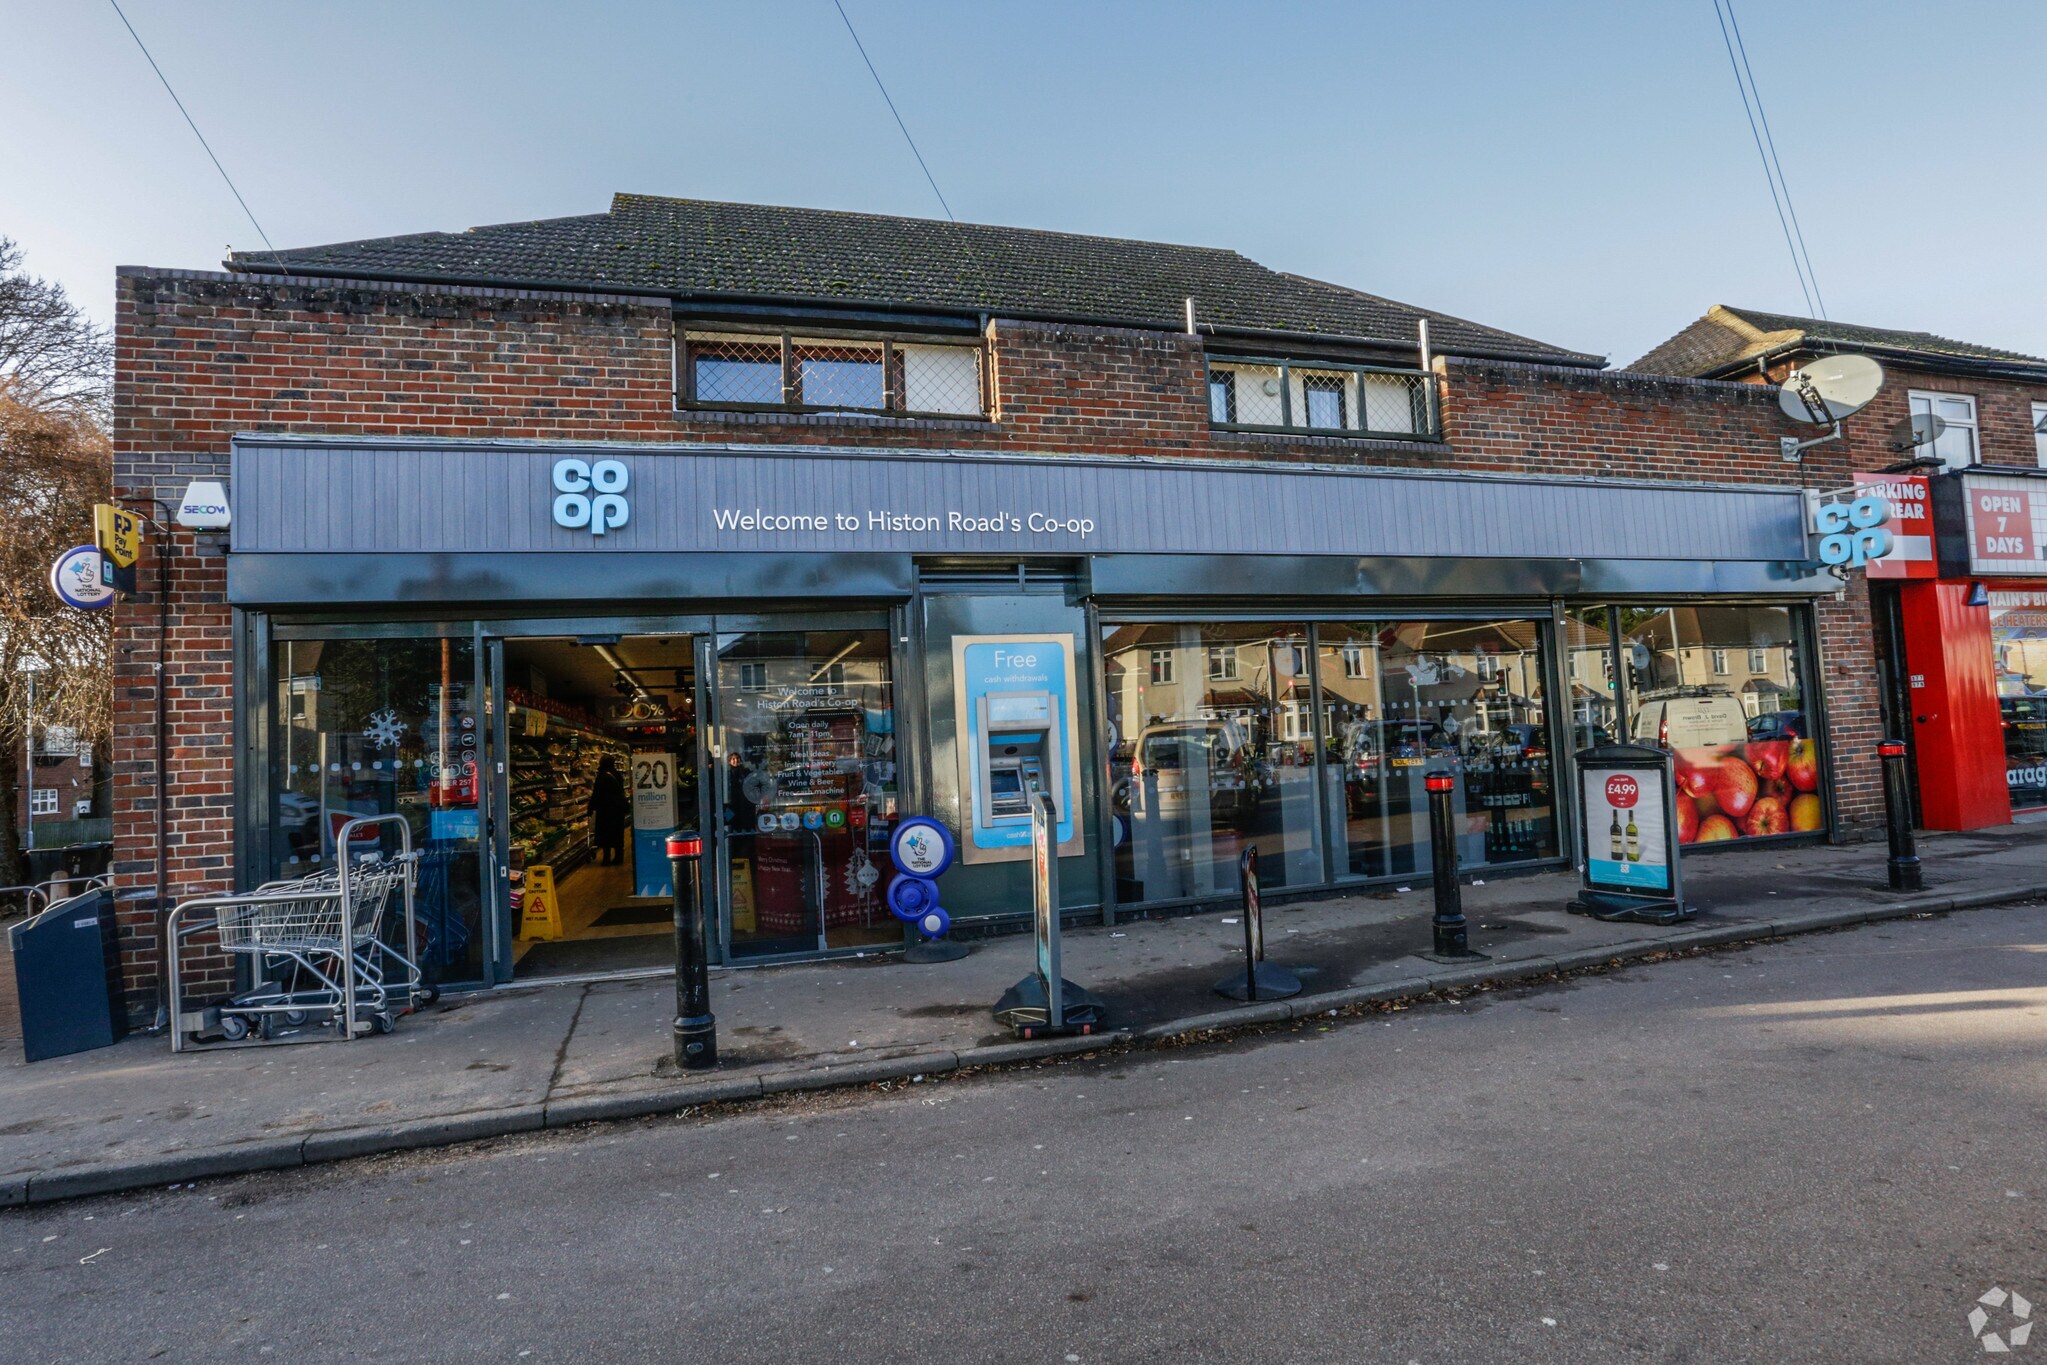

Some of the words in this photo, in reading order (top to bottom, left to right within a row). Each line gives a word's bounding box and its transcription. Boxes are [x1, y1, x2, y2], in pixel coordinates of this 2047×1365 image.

[1980, 495, 2021, 513] OPEN
[184, 505, 225, 514] SECOM
[713, 509, 828, 531] Welcome
[835, 512, 860, 531] to
[868, 510, 940, 532] Histon
[948, 511, 1022, 532] Road's
[1028, 512, 1095, 539] Co-op
[1997, 516, 2007, 533] 7
[114, 534, 127, 548] Pay
[1985, 536, 2024, 554] DAYS
[114, 547, 133, 560] Point
[2033, 591, 2047, 606] BI
[994, 650, 1037, 668] Free
[984, 674, 1002, 683] cash
[1003, 673, 1048, 683] withdrawals
[777, 687, 824, 696] Welcome
[757, 700, 790, 709] Histon
[792, 699, 825, 708] Road's
[827, 698, 858, 707] Co-op
[788, 721, 810, 729] Open
[811, 720, 829, 730] daily
[811, 730, 830, 738] 11pm
[784, 760, 810, 768] Instore
[811, 759, 836, 767] bakery
[804, 768, 844, 777] Vegetables
[431, 779, 457, 787] UNER
[815, 787, 844, 795] machine
[1607, 784, 1636, 795] £4.99
[638, 791, 667, 801] million
